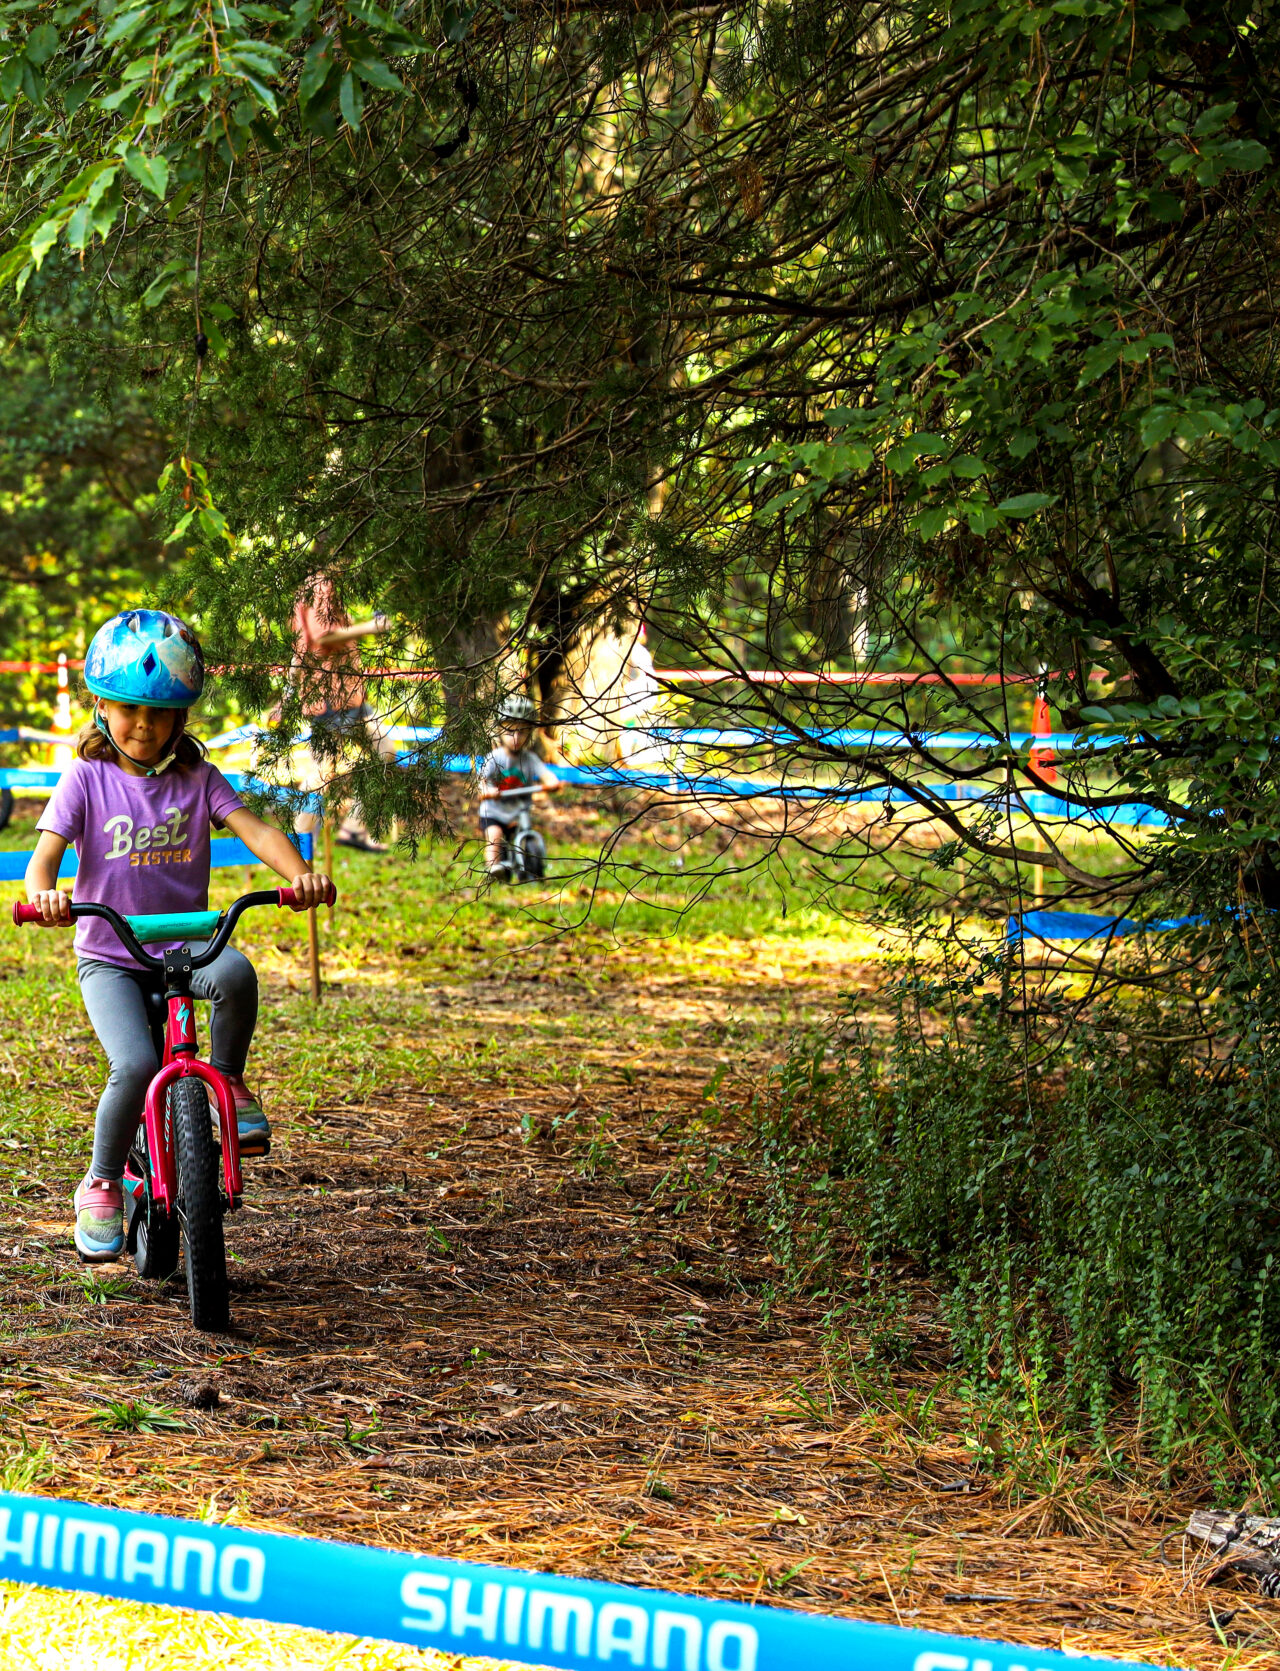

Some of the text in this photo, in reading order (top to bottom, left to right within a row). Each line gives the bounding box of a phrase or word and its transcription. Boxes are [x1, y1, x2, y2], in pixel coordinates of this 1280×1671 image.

[104, 807, 189, 860] Best
[129, 850, 192, 867] SISTER
[401, 1571, 761, 1671] SHIMANO
